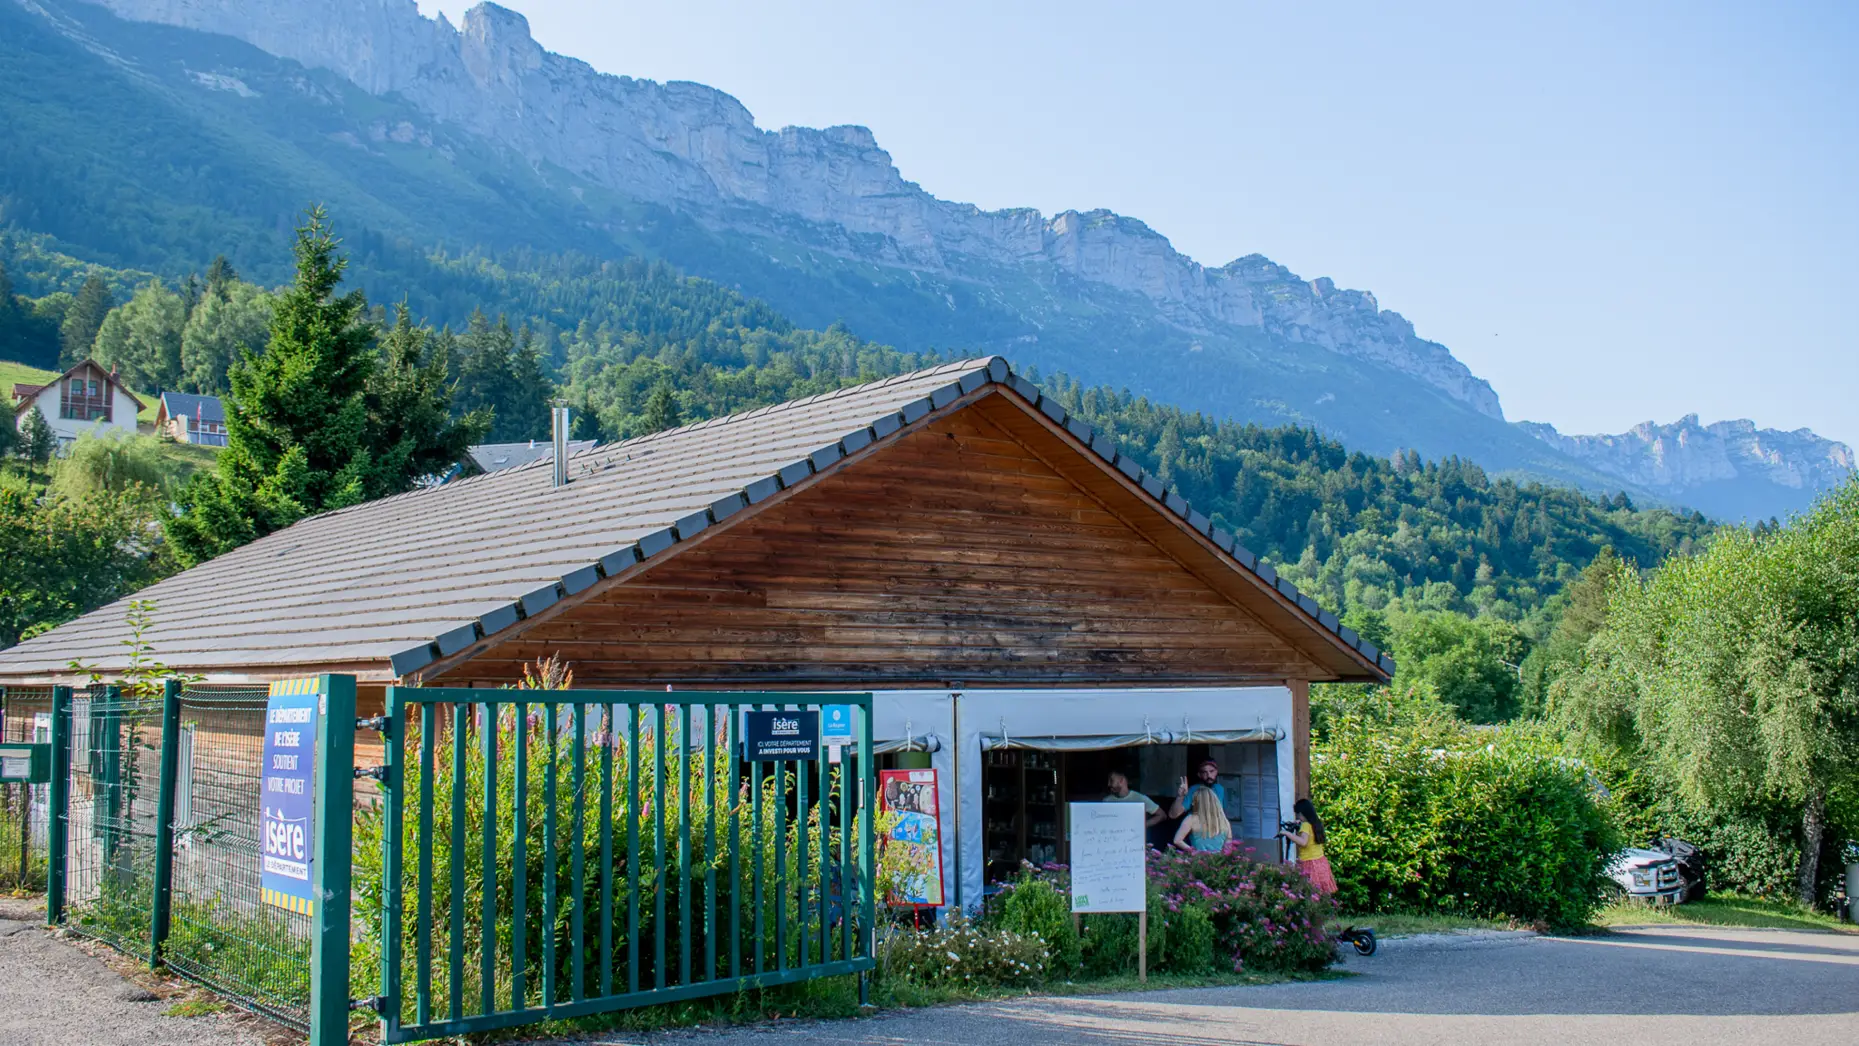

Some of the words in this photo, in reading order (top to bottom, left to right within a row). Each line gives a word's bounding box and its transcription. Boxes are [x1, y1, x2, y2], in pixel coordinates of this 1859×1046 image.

[276, 706, 312, 723] DÉPARTEMENT
[773, 717, 798, 730] isère
[274, 732, 281, 747] DE
[779, 739, 812, 747] DÉPARTEMENT
[273, 755, 298, 770] SOUTIENT
[268, 777, 284, 792] VOTRE
[284, 779, 304, 794] PROJET
[266, 806, 304, 859] isère
[271, 860, 307, 876] DÉPARTEMENT
